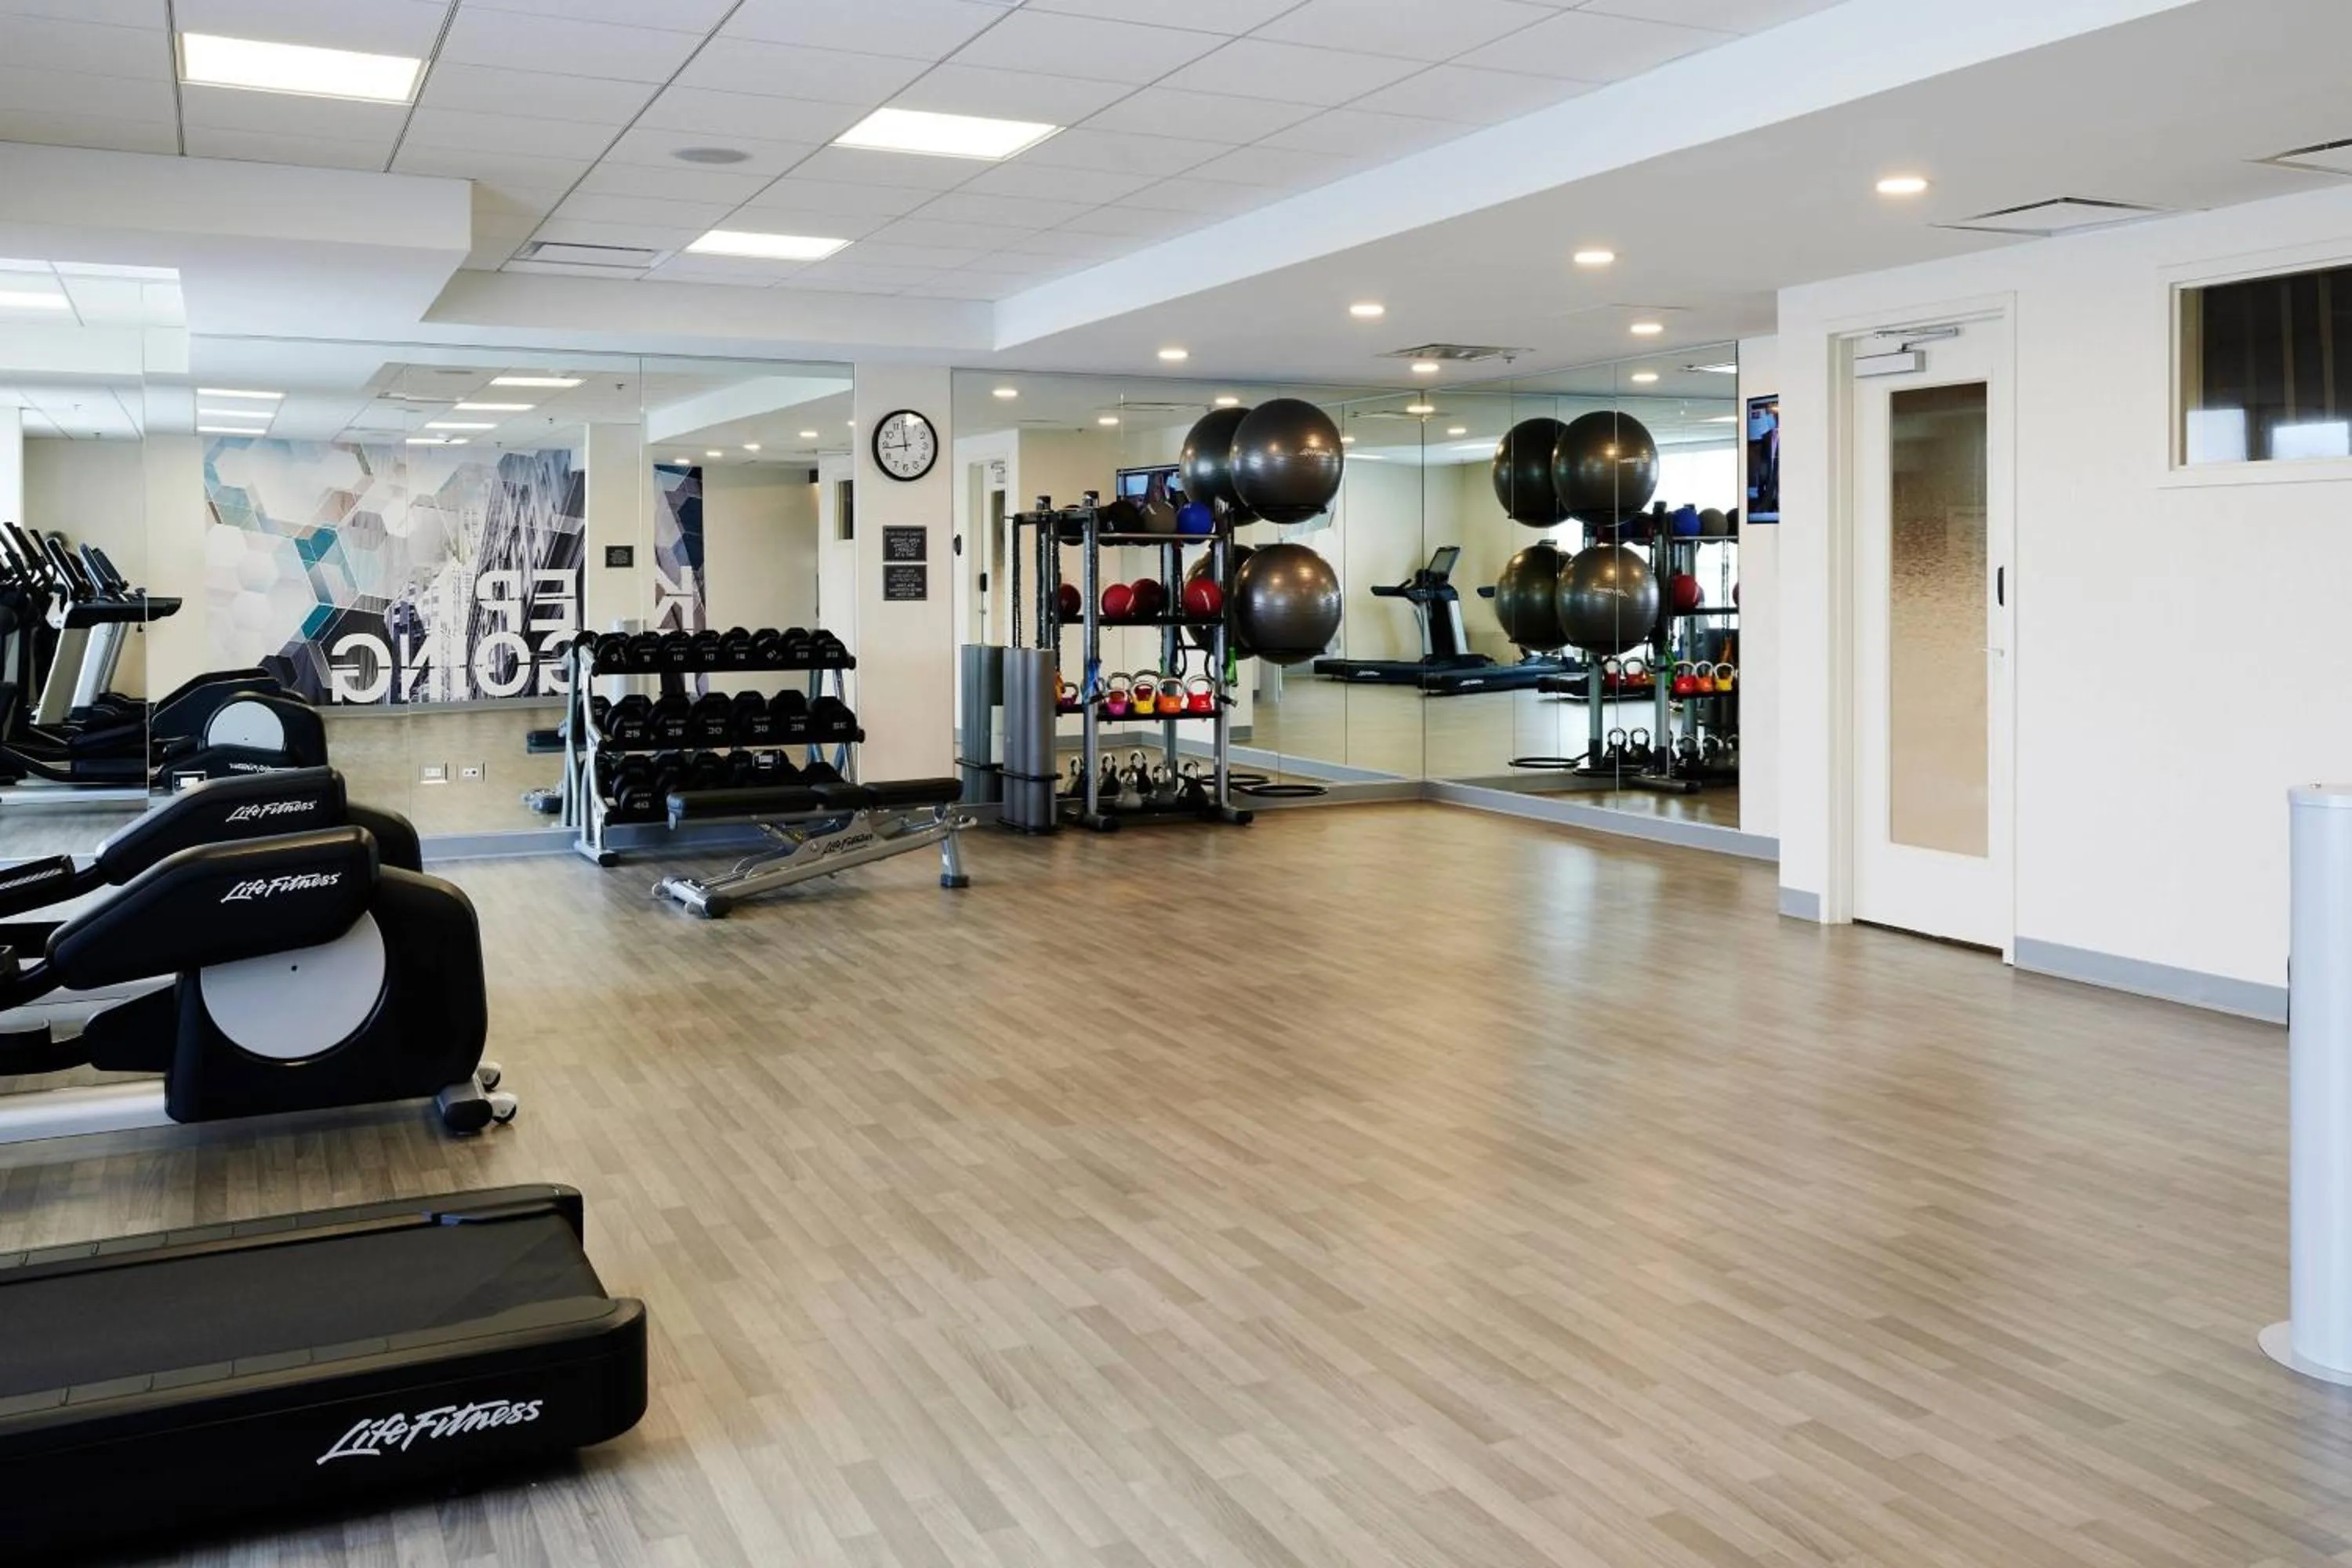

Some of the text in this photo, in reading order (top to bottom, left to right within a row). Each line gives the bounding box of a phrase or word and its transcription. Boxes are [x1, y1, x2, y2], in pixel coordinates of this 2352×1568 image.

[667, 728, 683, 737] 25
[753, 724, 769, 733] 30
[625, 729, 641, 739] 25
